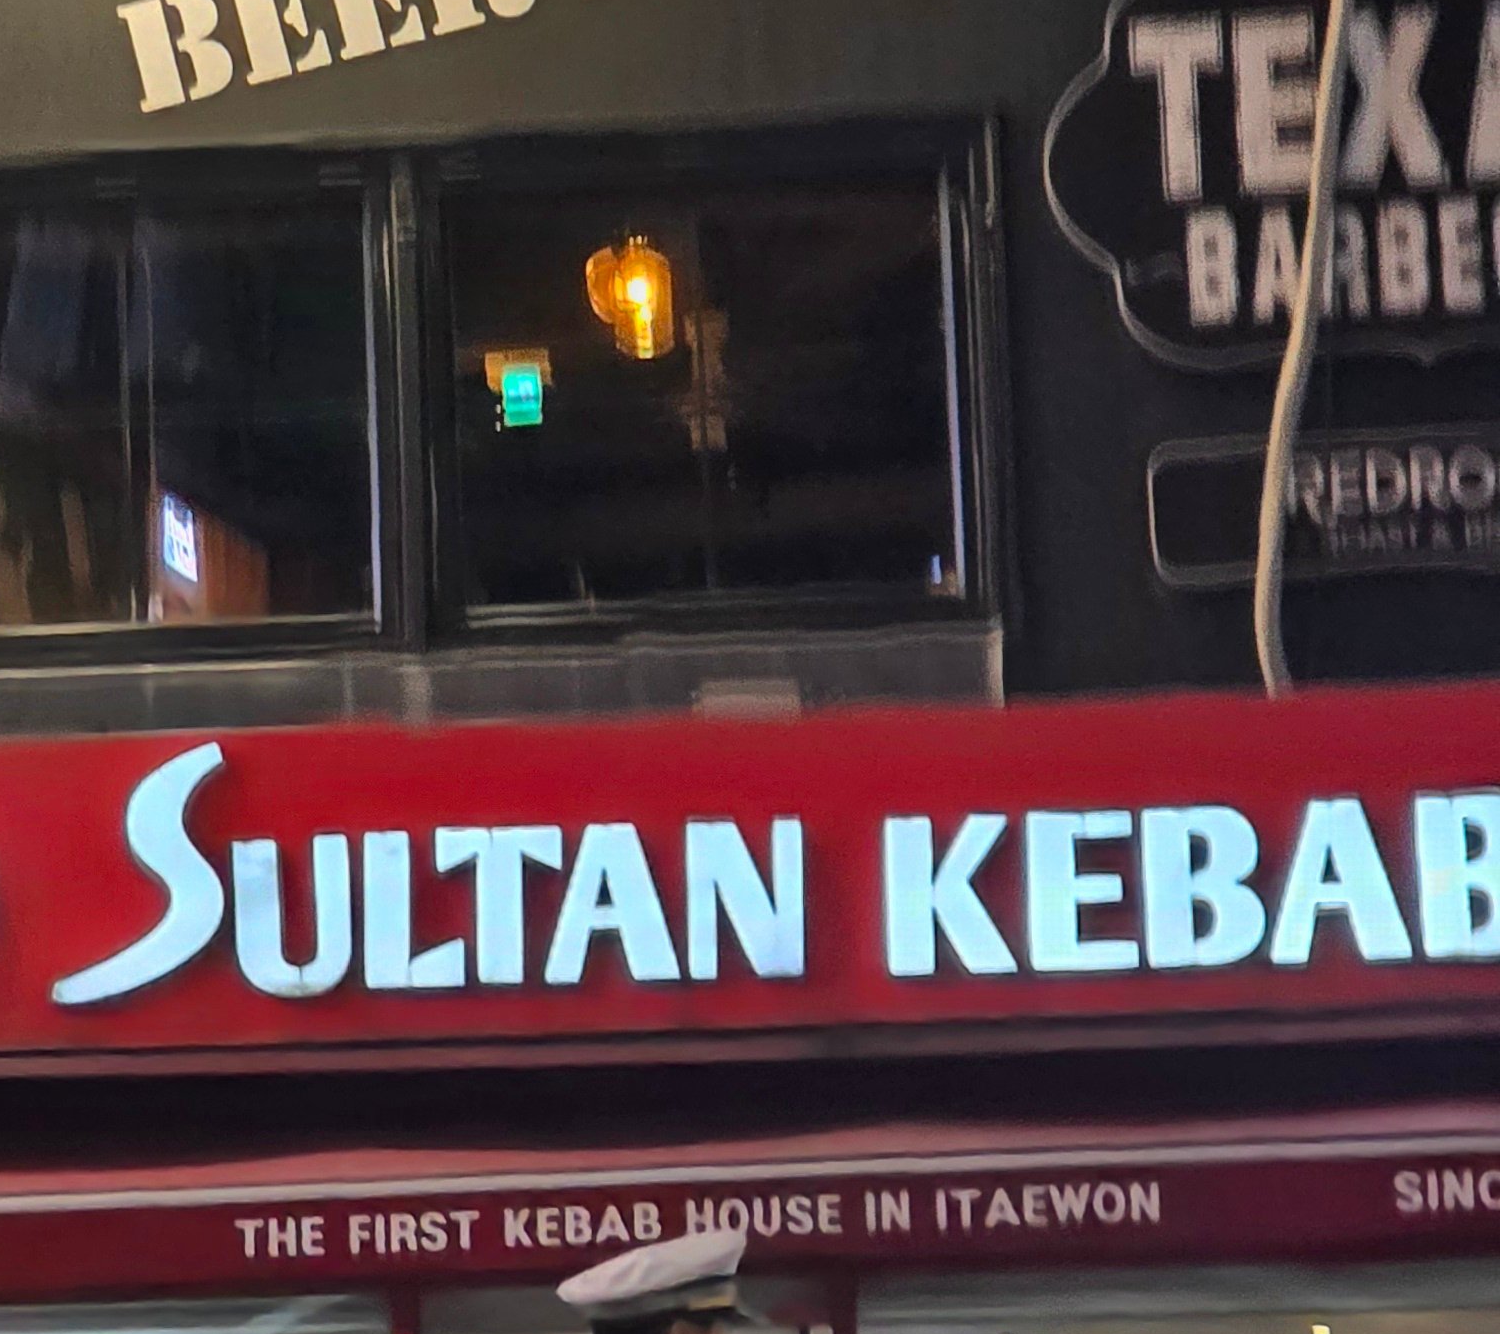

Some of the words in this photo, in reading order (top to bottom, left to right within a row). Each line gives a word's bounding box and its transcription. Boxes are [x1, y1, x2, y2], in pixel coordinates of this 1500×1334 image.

[1186, 193, 1500, 327] BARBE
[51, 741, 805, 1005] SULTAN
[883, 787, 1500, 978] KEBAB
[235, 1216, 325, 1258] THE
[348, 1209, 480, 1255] FIRST
[503, 1202, 662, 1248] KEBAB
[685, 1193, 843, 1237] HOUSE
[864, 1189, 910, 1235] IN
[936, 1181, 1161, 1233] ITAEWON
